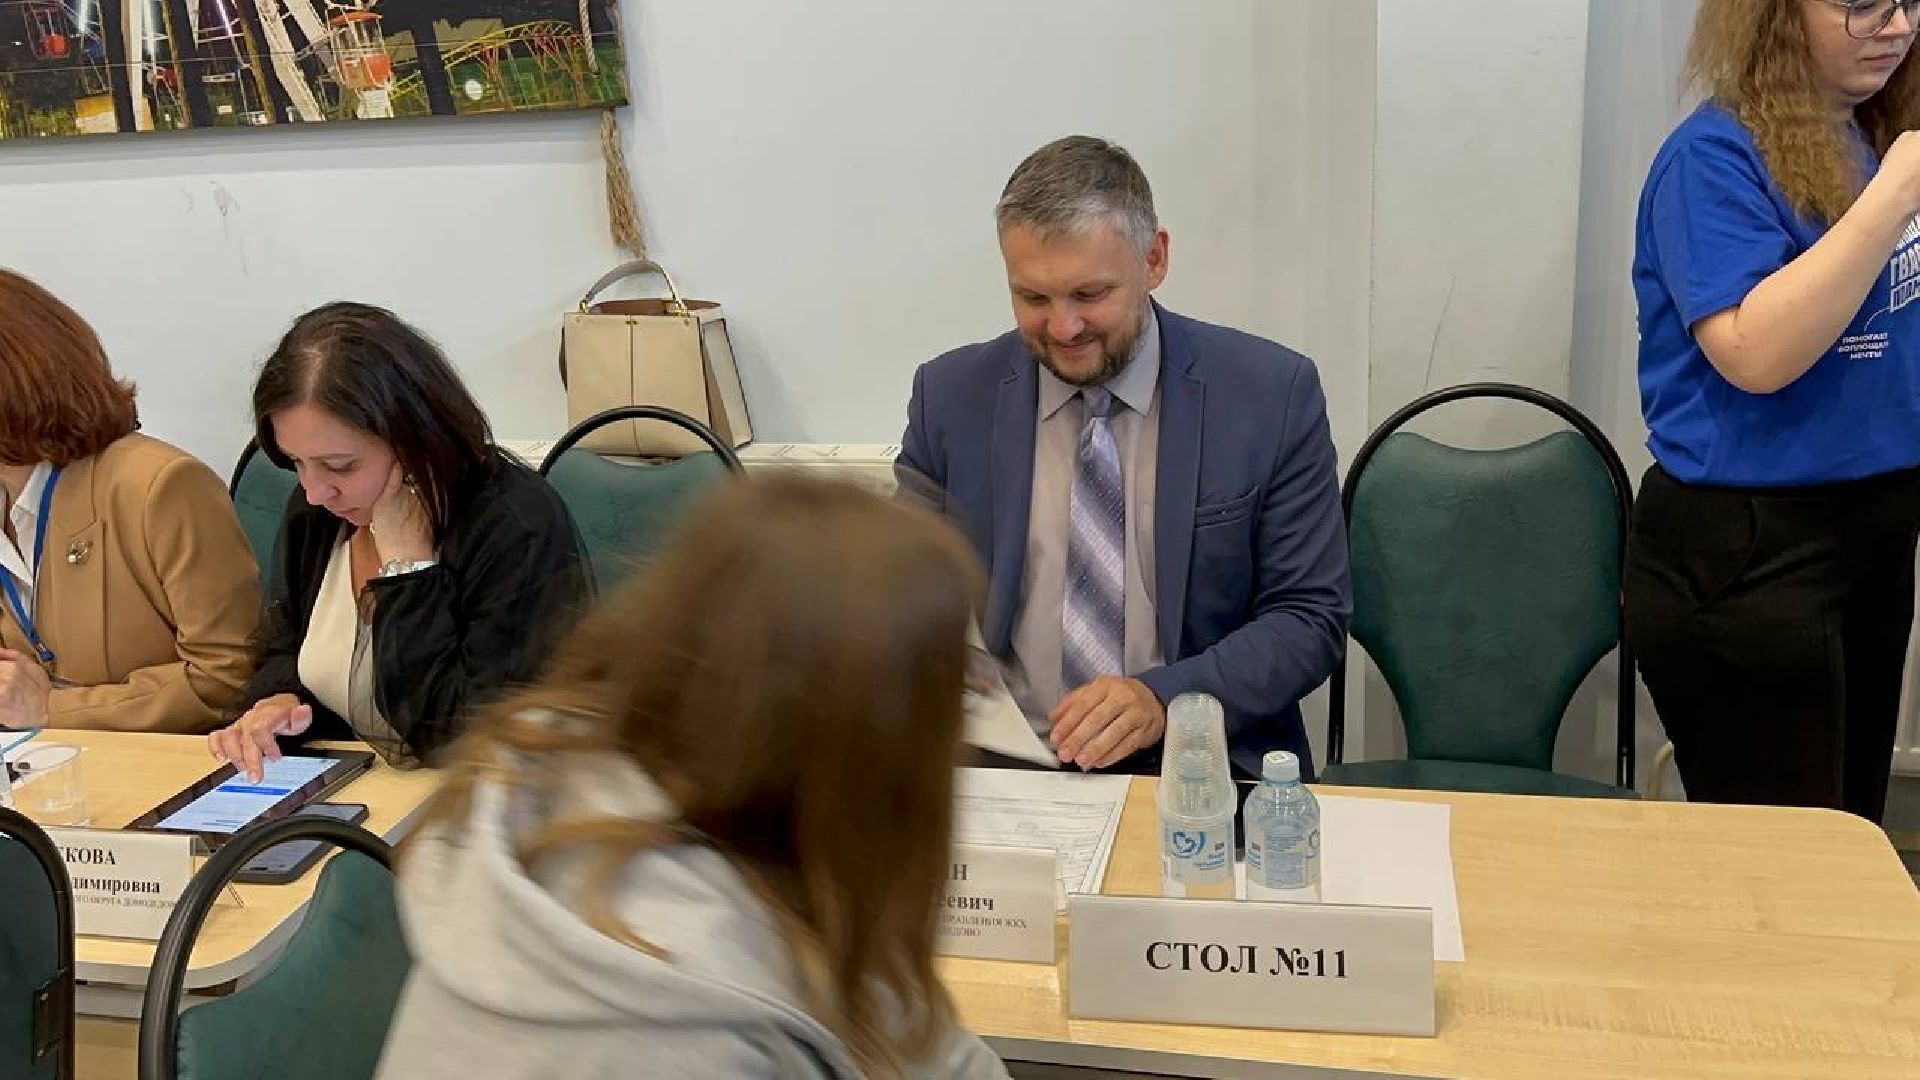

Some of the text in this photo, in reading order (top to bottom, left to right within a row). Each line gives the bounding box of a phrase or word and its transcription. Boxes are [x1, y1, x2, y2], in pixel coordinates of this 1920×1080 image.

[61, 846, 116, 865] КОВА
[1146, 941, 1348, 979] СТОЛ №11
